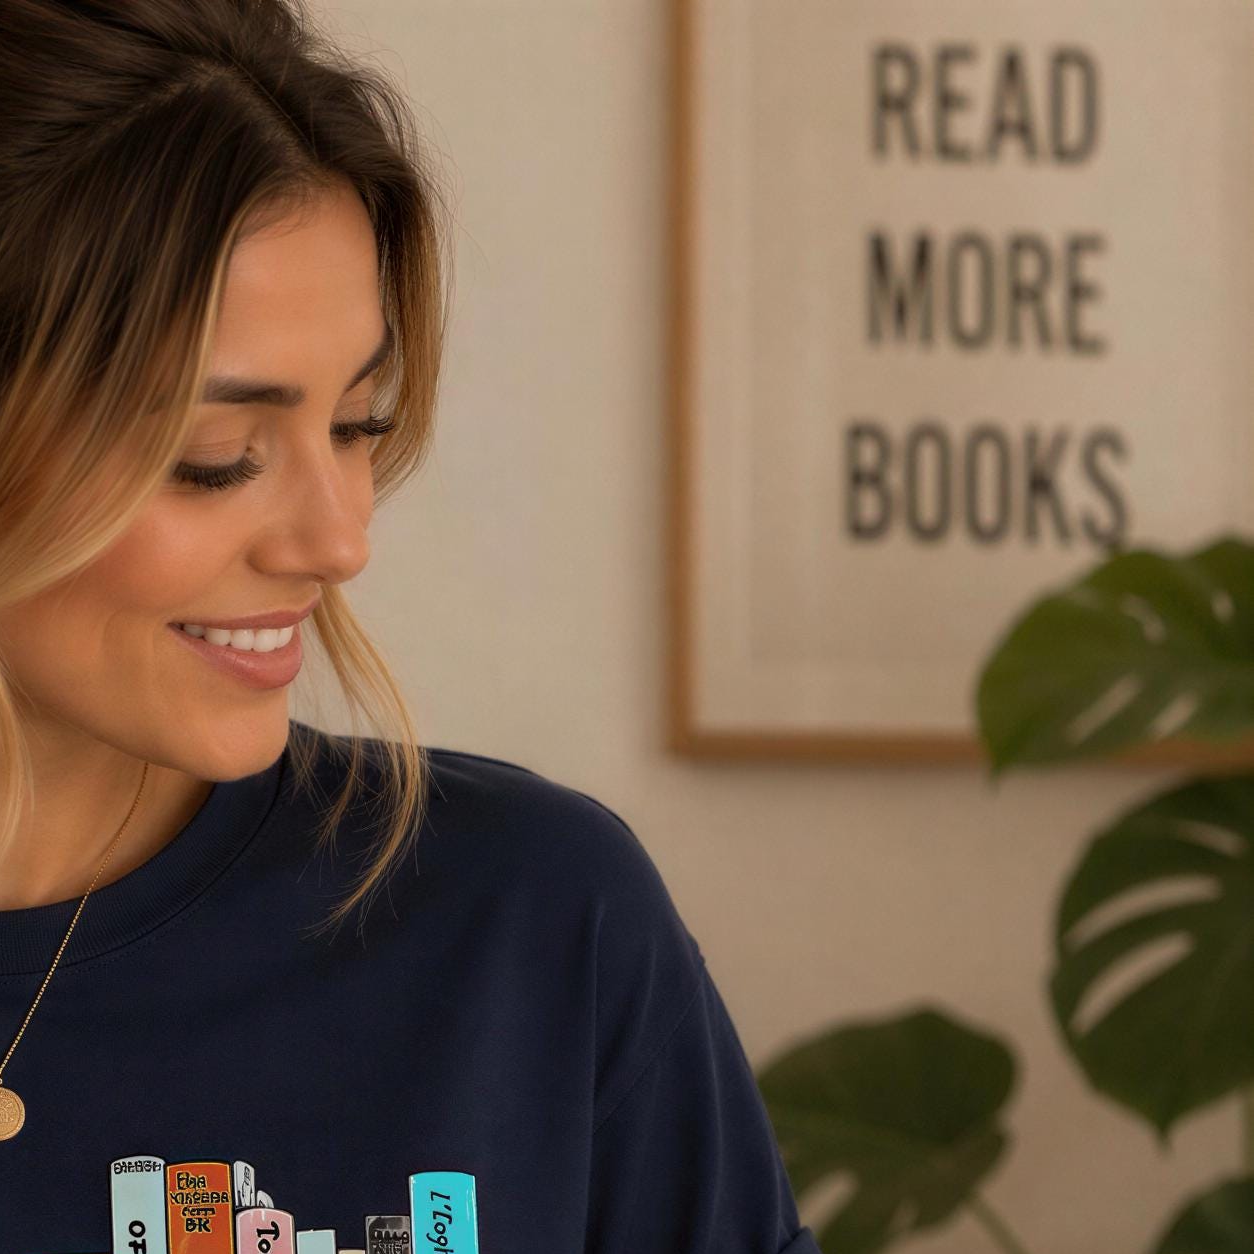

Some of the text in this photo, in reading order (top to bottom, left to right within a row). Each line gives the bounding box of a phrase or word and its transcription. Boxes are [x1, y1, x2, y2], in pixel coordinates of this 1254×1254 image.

[871, 42, 1101, 165] READ
[865, 228, 1107, 356] MORE
[846, 419, 1131, 550] BOOKS
[128, 1220, 147, 1254] OF
